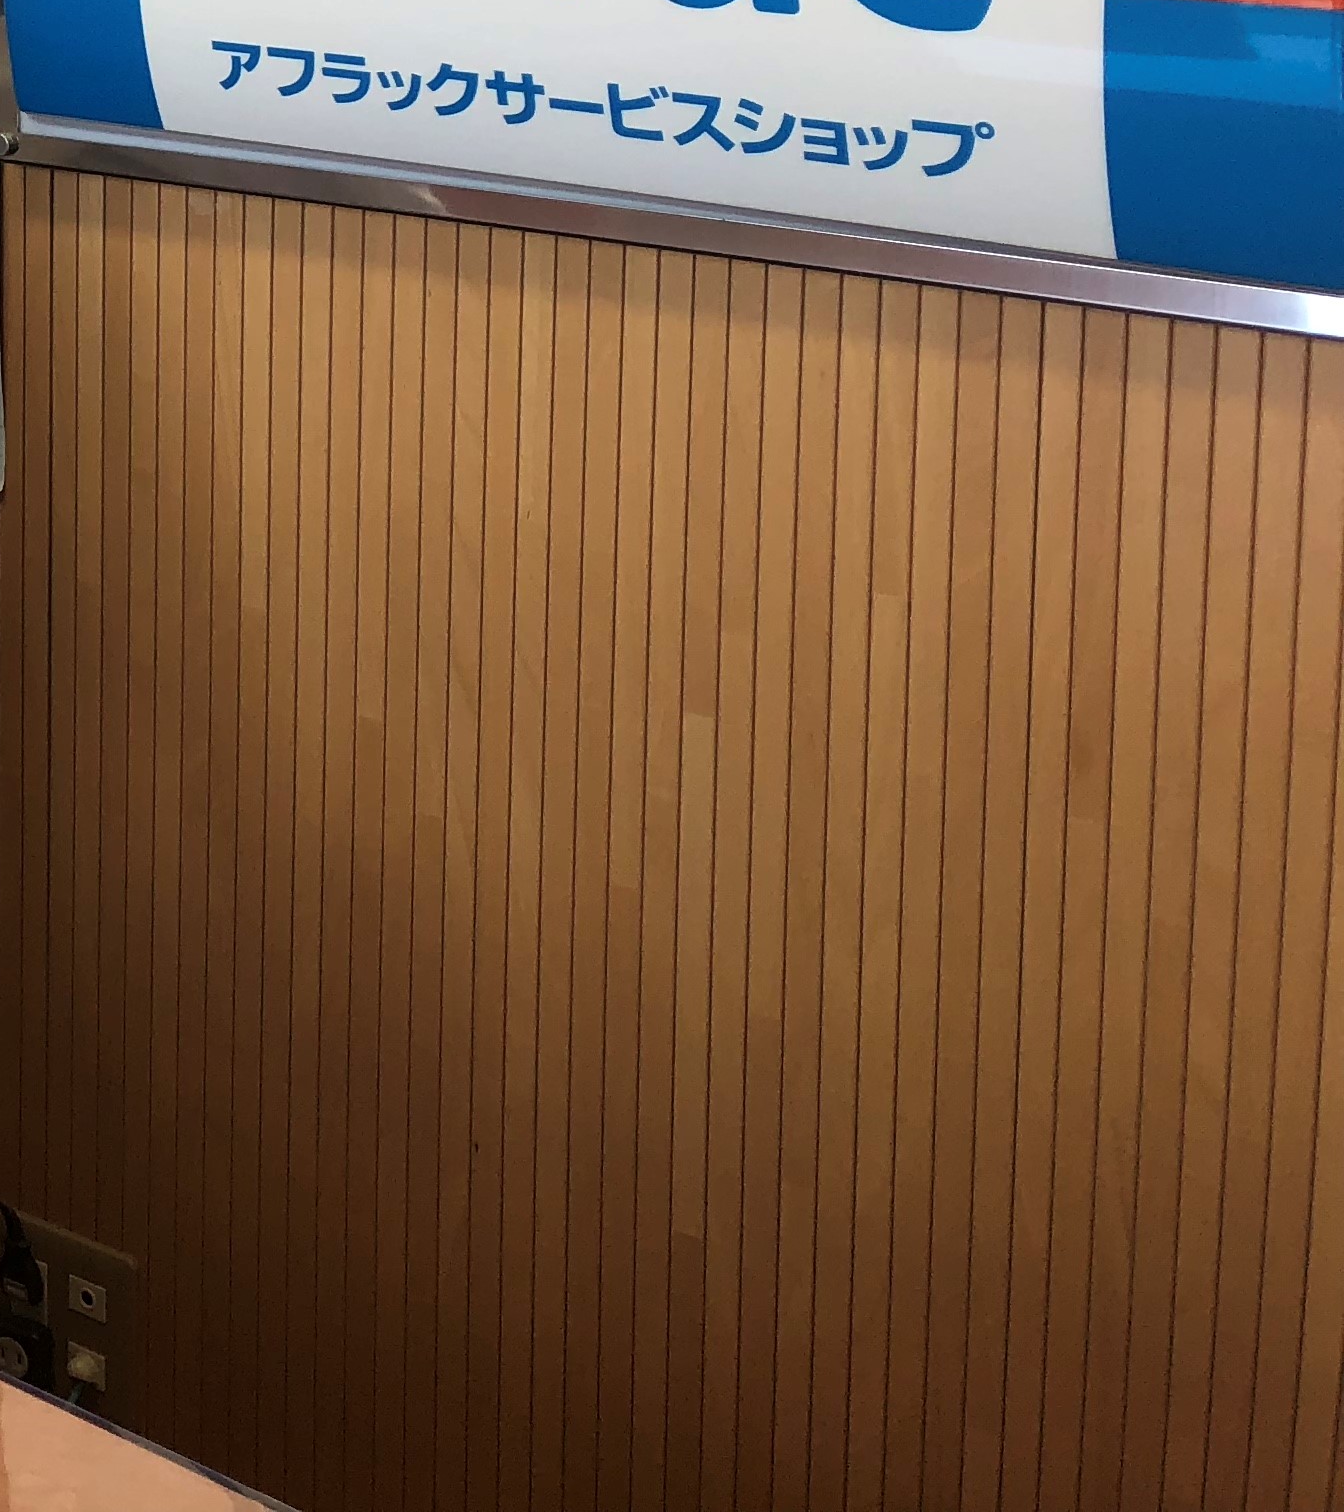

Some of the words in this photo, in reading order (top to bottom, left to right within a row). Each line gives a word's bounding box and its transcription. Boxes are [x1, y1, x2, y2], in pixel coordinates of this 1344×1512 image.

[208, 39, 996, 180] アフラックサービスショップ
